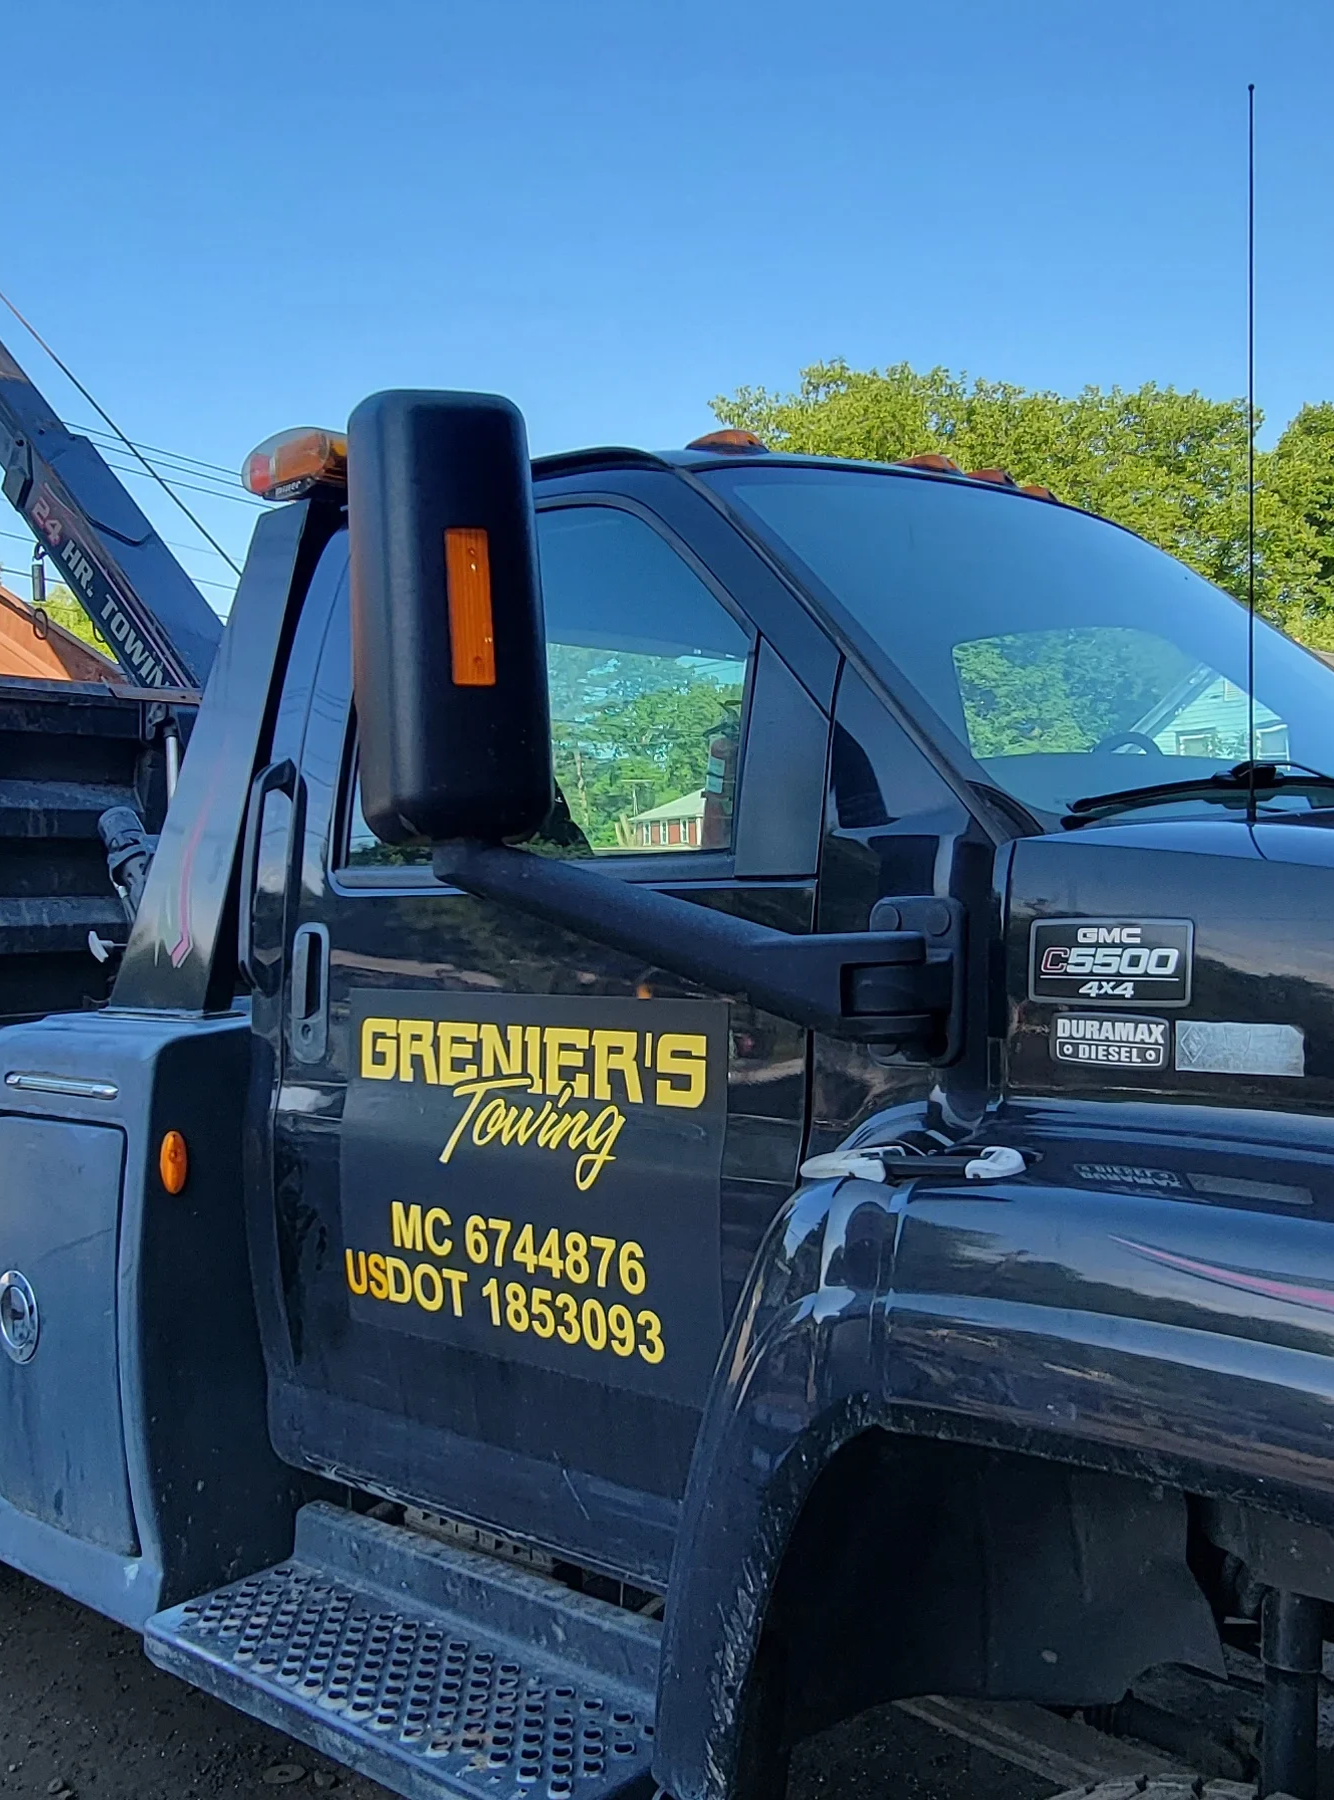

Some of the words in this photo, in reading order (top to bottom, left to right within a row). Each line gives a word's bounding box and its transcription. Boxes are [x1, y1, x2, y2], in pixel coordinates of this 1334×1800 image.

[32, 497, 62, 547] 24
[61, 540, 94, 597] HR.
[1041, 947, 1180, 975] C5500
[1077, 927, 1142, 943] GMC
[360, 1017, 707, 1109] GRENIER'S
[1057, 1018, 1165, 1044] DURAMAX
[1078, 1046, 1142, 1063] DIESEL
[438, 1077, 626, 1191] Towing
[391, 1201, 453, 1256] MC
[465, 1214, 646, 1296] 6744876
[345, 1248, 468, 1317] USDOT
[481, 1277, 665, 1365] 1853093
